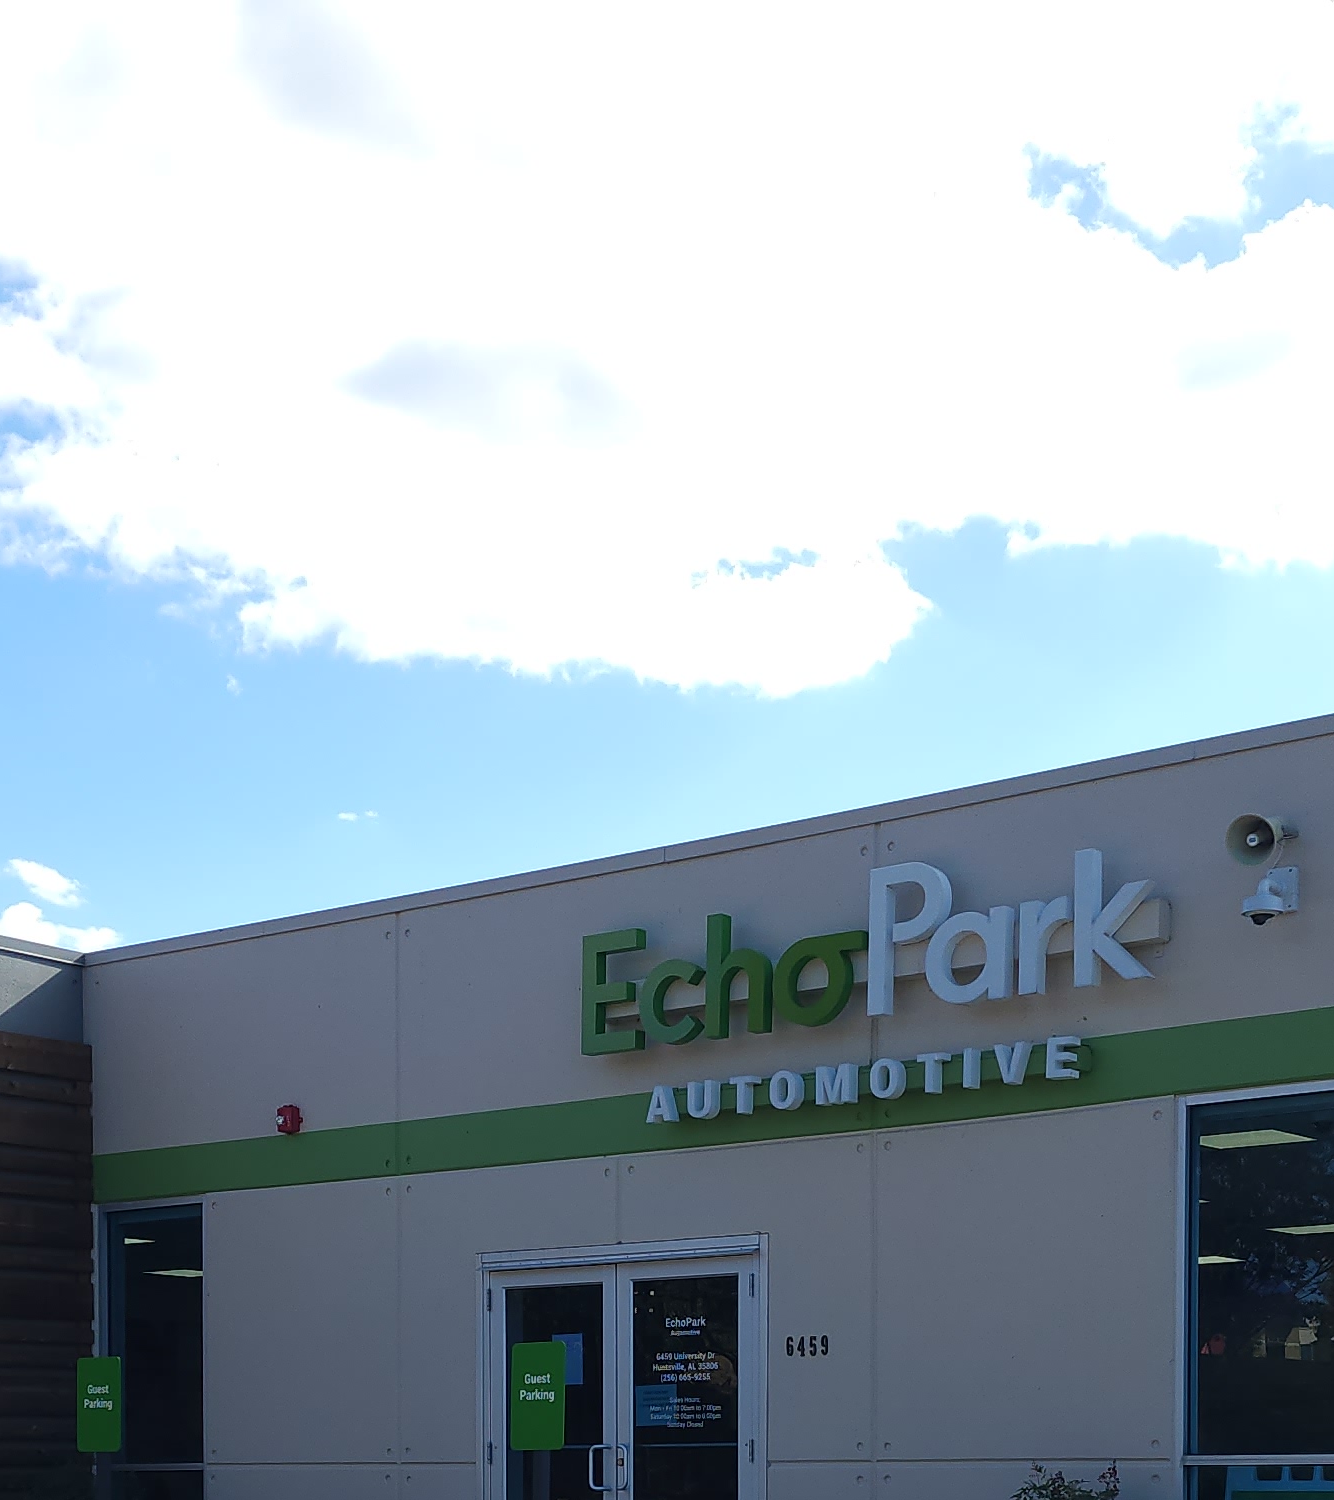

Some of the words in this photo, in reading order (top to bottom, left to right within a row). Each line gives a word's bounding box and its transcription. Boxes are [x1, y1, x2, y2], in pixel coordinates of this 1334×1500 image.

[581, 848, 1157, 1056] EchoPark
[646, 1035, 1082, 1124] AUTOMOTIVE
[665, 1316, 707, 1328] EchoPark
[786, 1334, 829, 1357] 6459
[673, 1351, 707, 1361] University
[707, 1351, 716, 1360] Dr
[687, 1363, 697, 1371] AL
[524, 1372, 551, 1384] Guest
[87, 1384, 109, 1395] Guest
[519, 1388, 555, 1403] Parking
[83, 1398, 113, 1411] Parking
